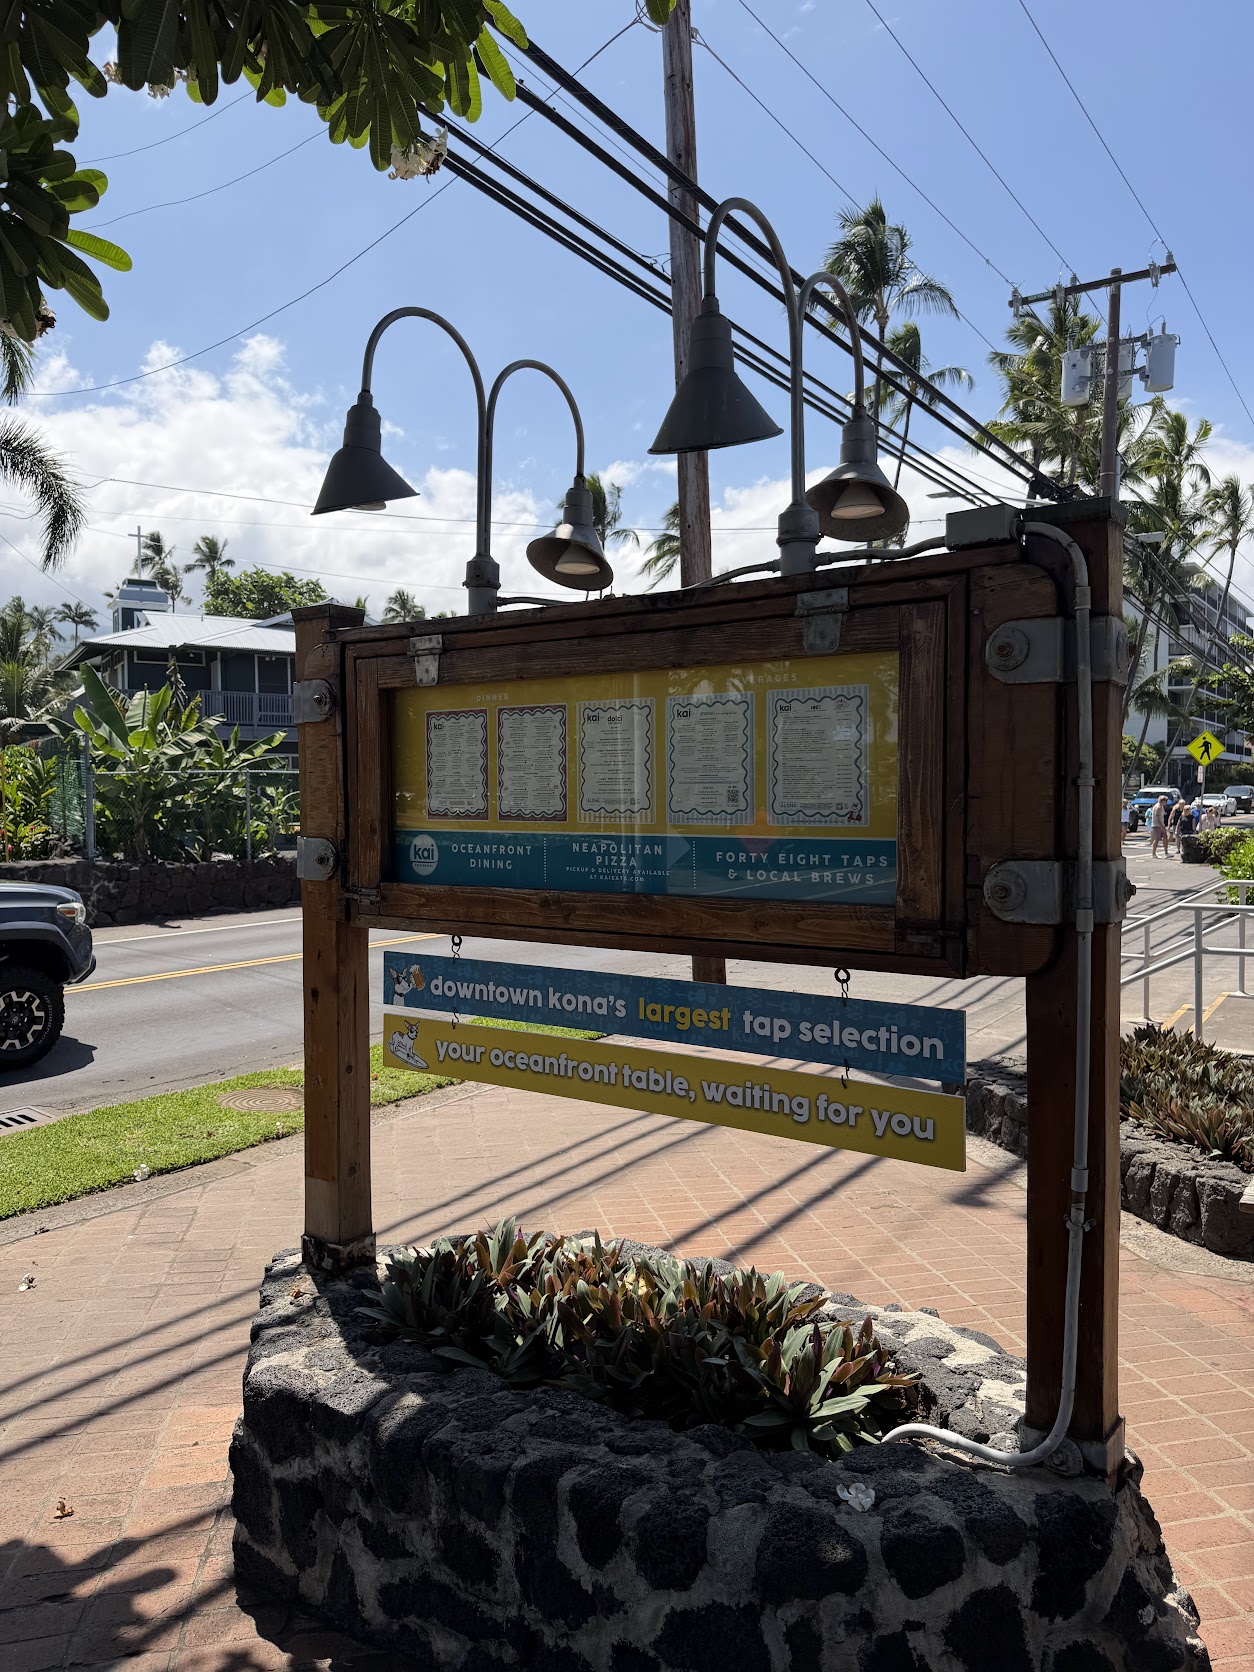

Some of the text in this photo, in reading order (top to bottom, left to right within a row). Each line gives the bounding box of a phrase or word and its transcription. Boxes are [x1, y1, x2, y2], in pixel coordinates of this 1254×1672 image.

[676, 708, 691, 718] kai
[779, 704, 792, 712] kai
[586, 712, 600, 722] kai
[433, 722, 444, 731] kai
[413, 843, 435, 860] kai
[451, 843, 532, 856] OCEANFRONT
[572, 842, 662, 855] NEAPOLITAN
[469, 858, 512, 870] DINING
[596, 855, 637, 867] PIZZA
[716, 851, 888, 867] FORTY EIGHT TAPS
[598, 867, 630, 875] DELIVERY
[728, 868, 875, 885] & LOCAL BREWS
[430, 975, 944, 1060] downtown kona's largest tap selection
[436, 1039, 934, 1141] your oceanfront table, waiting for you
